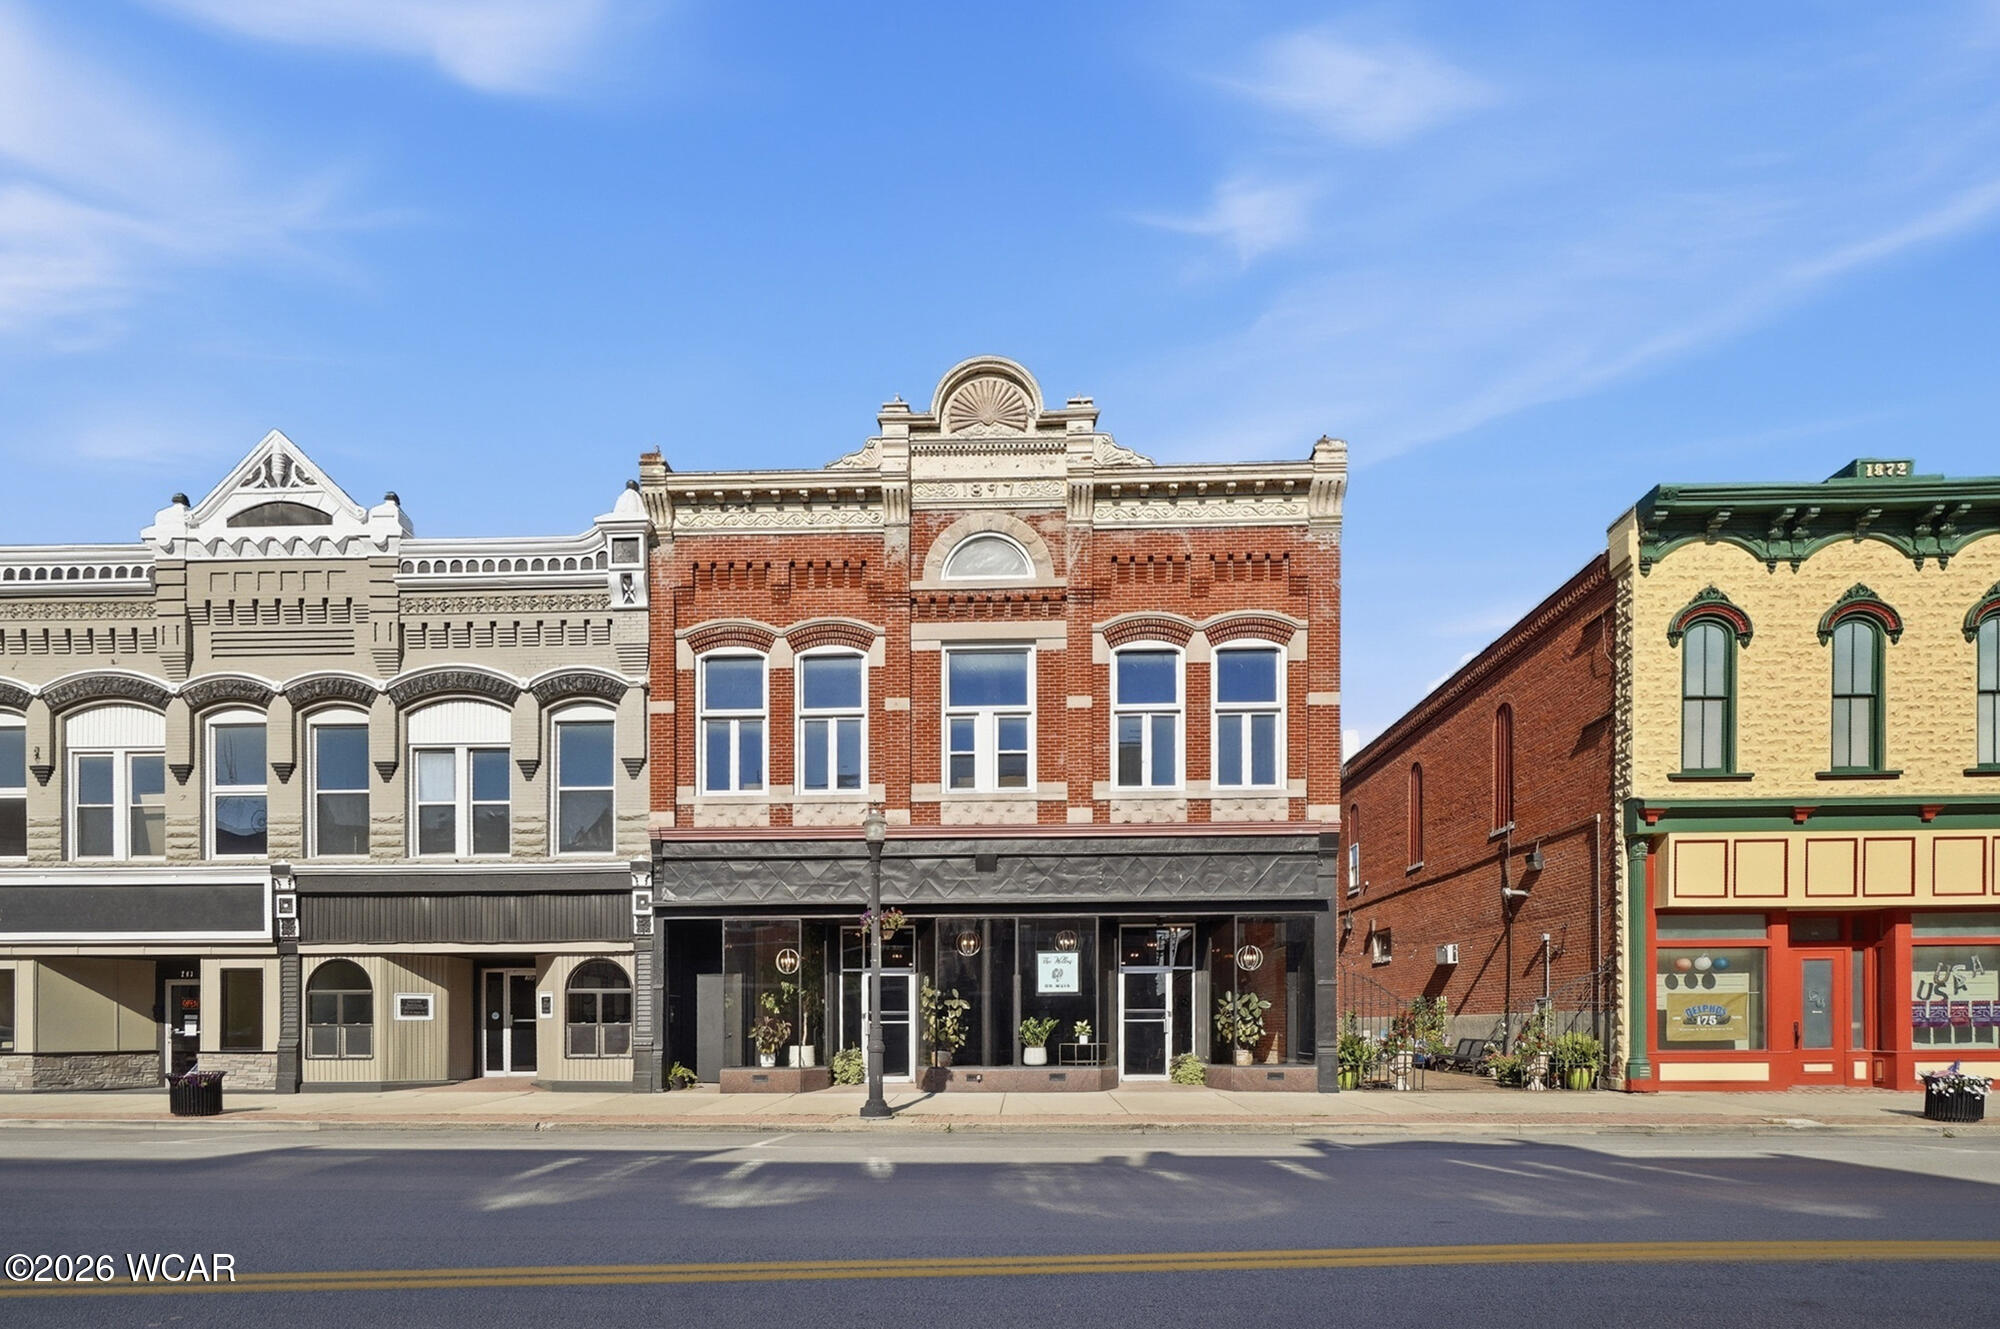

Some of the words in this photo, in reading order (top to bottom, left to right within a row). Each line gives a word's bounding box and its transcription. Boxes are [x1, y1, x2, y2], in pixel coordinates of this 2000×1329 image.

[1865, 462, 1907, 478] 1872
[962, 482, 1014, 497] 1897
[1685, 1004, 1728, 1017] DELPHOS
[1696, 1015, 1717, 1026] 175
